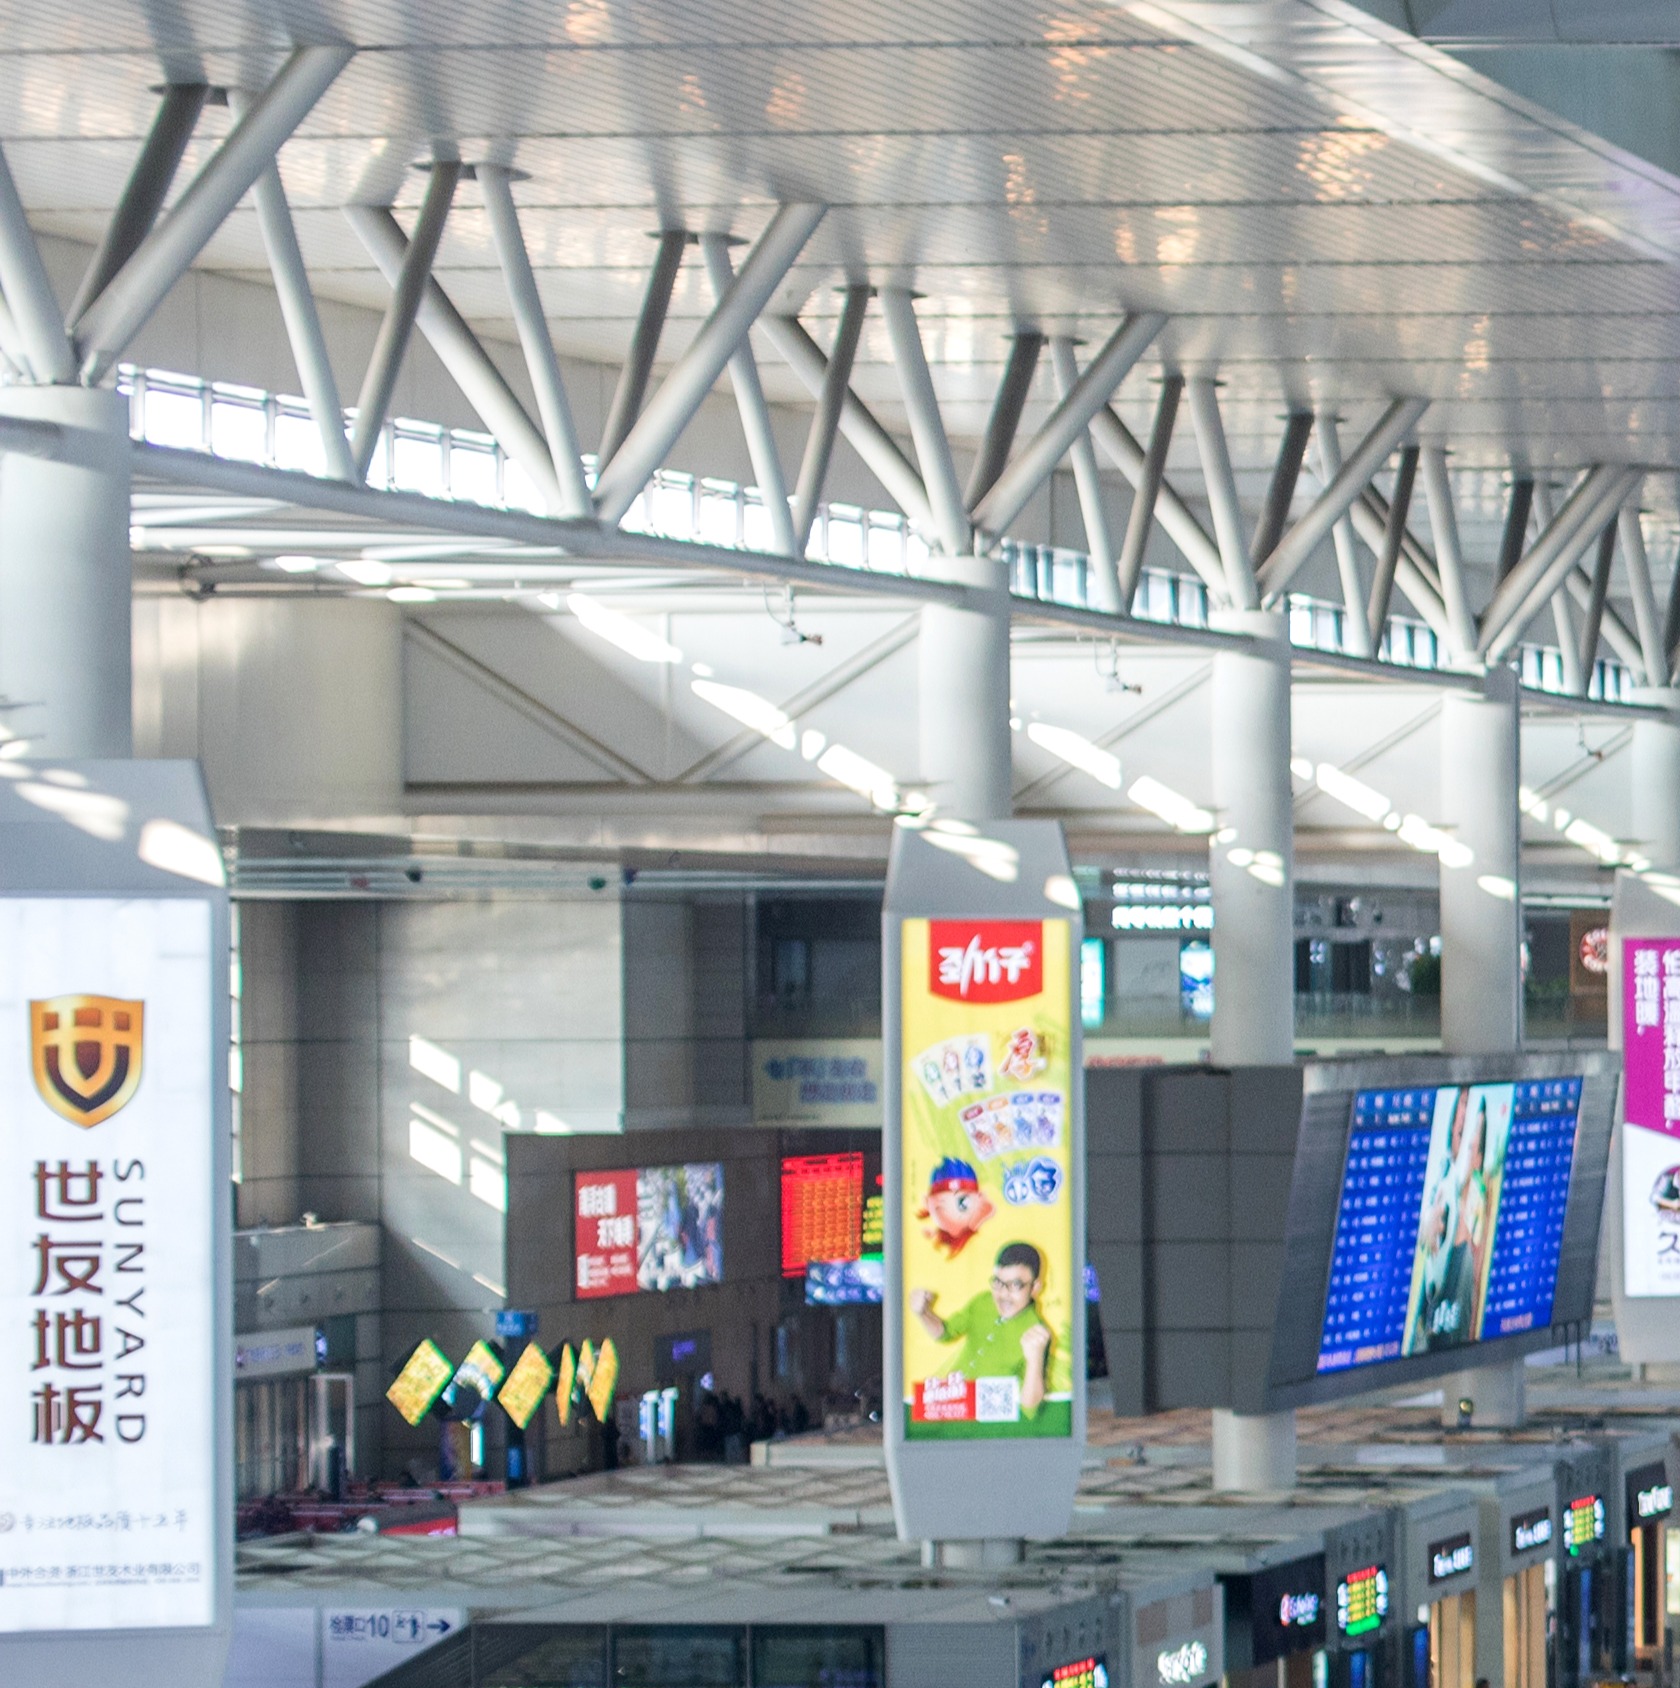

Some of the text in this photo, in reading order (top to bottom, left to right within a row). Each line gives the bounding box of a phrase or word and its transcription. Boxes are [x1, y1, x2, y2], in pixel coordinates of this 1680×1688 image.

[30, 1158, 105, 1446] 世友地板
[113, 1158, 148, 1445] SUNYARD
[367, 1614, 390, 1638] 10
